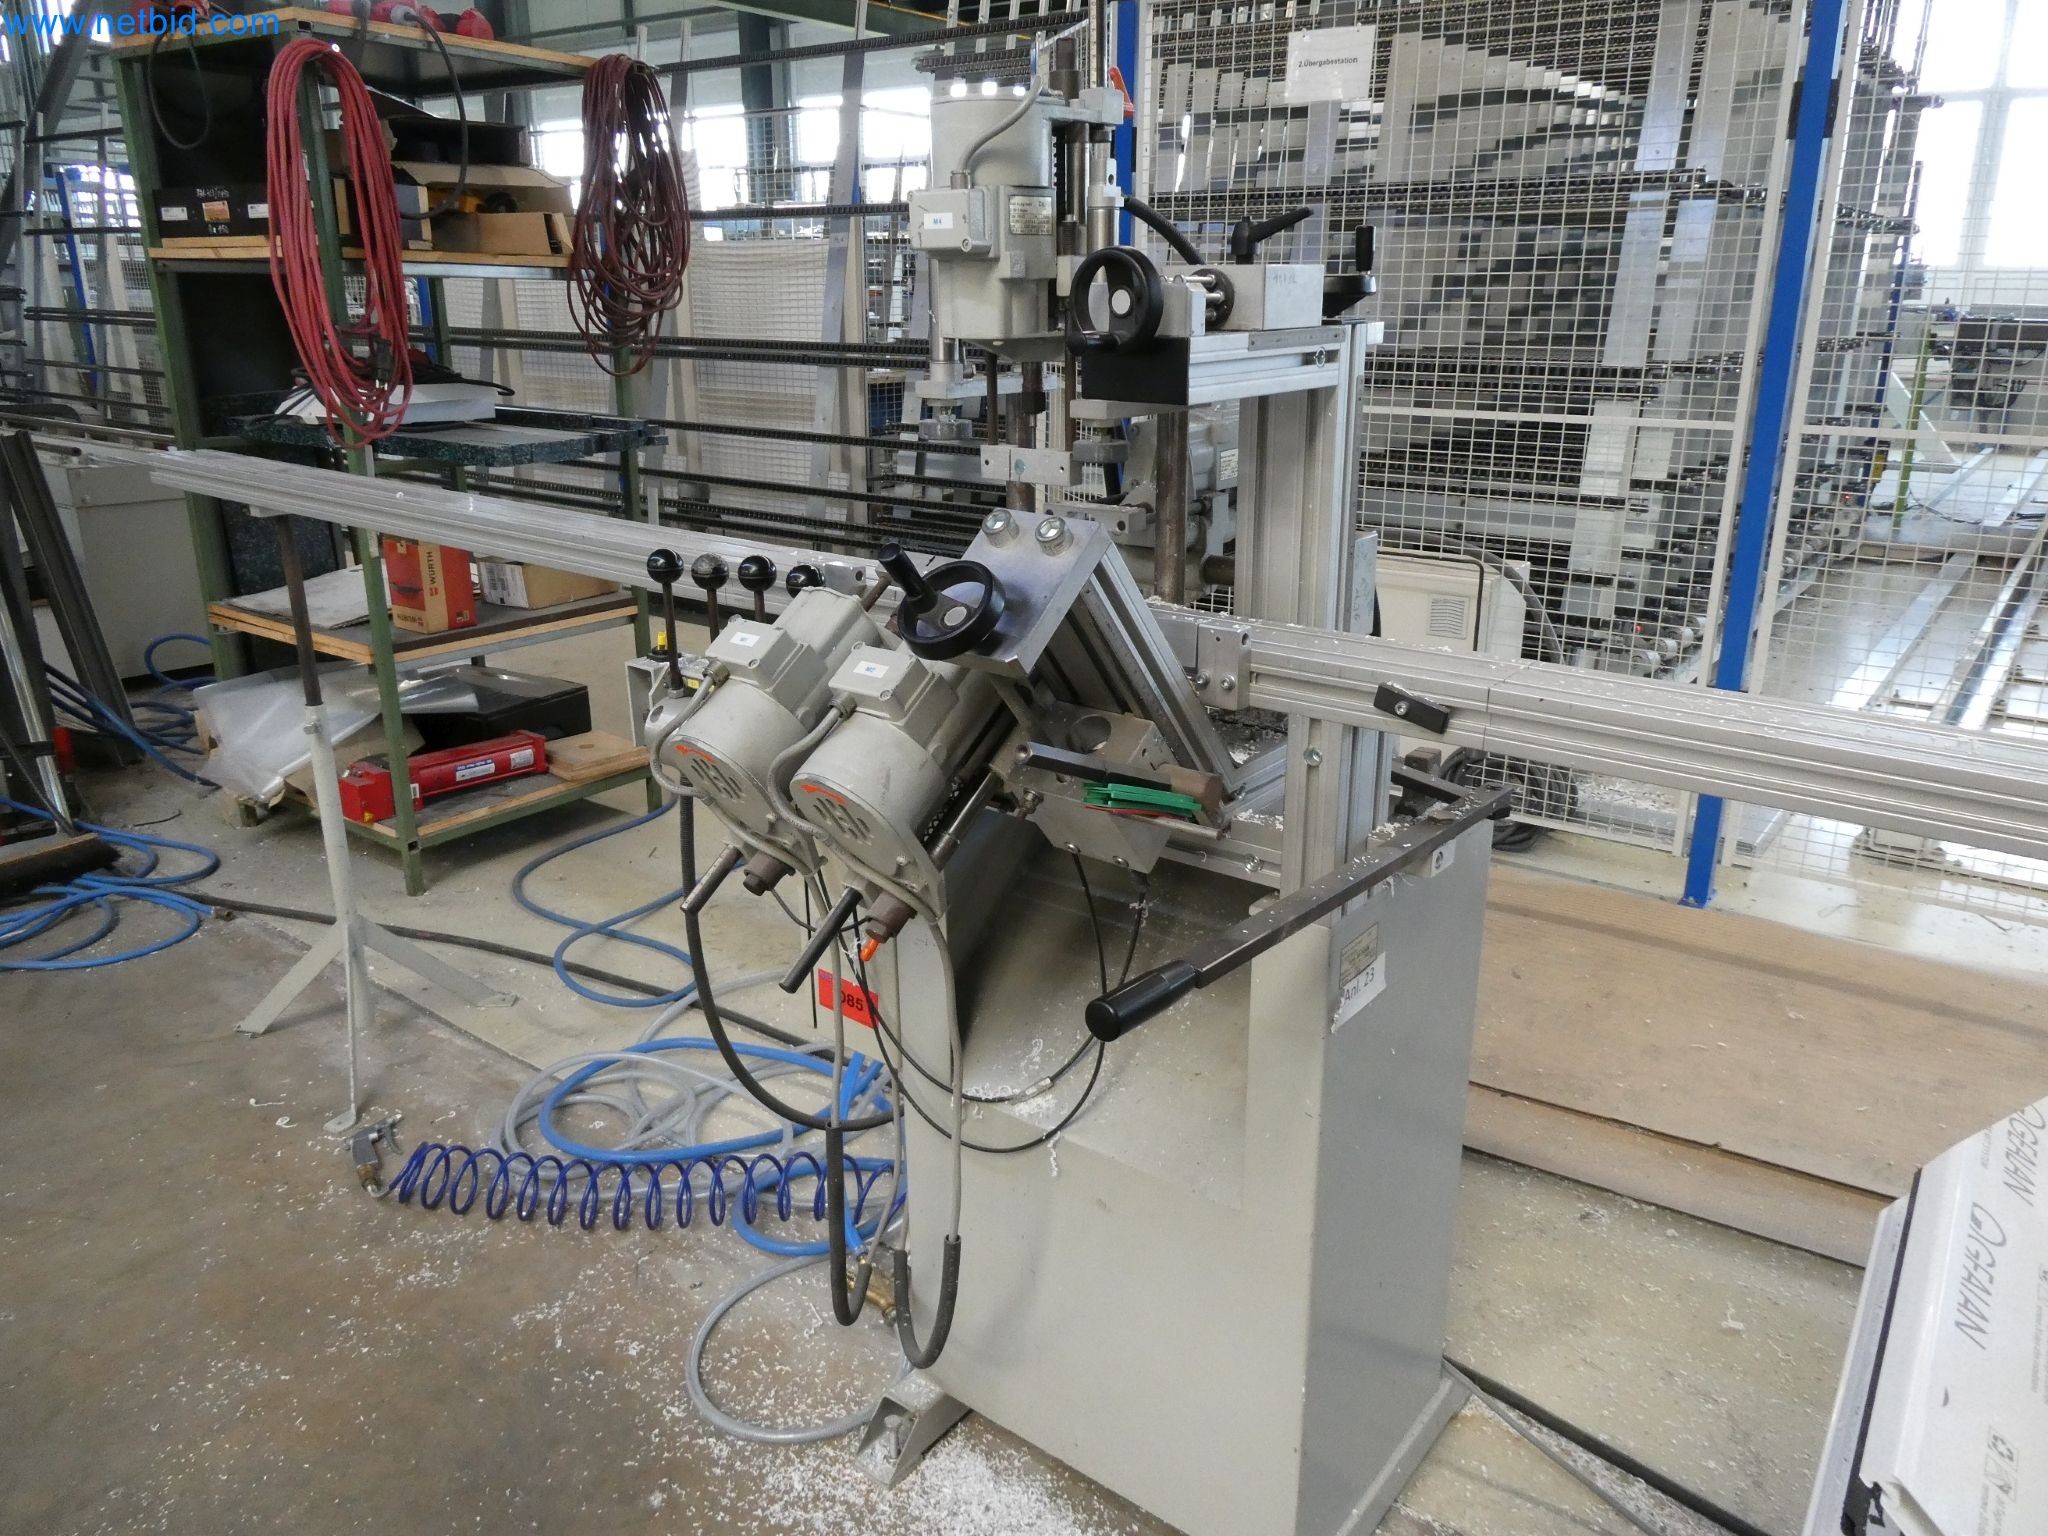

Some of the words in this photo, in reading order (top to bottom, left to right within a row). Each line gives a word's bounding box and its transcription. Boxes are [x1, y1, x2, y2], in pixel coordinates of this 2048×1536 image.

[933, 217, 943, 225] M4
[426, 551, 437, 585] WÜRTH
[1344, 980, 1362, 1002] Anl.
[1364, 966, 1375, 988] 23
